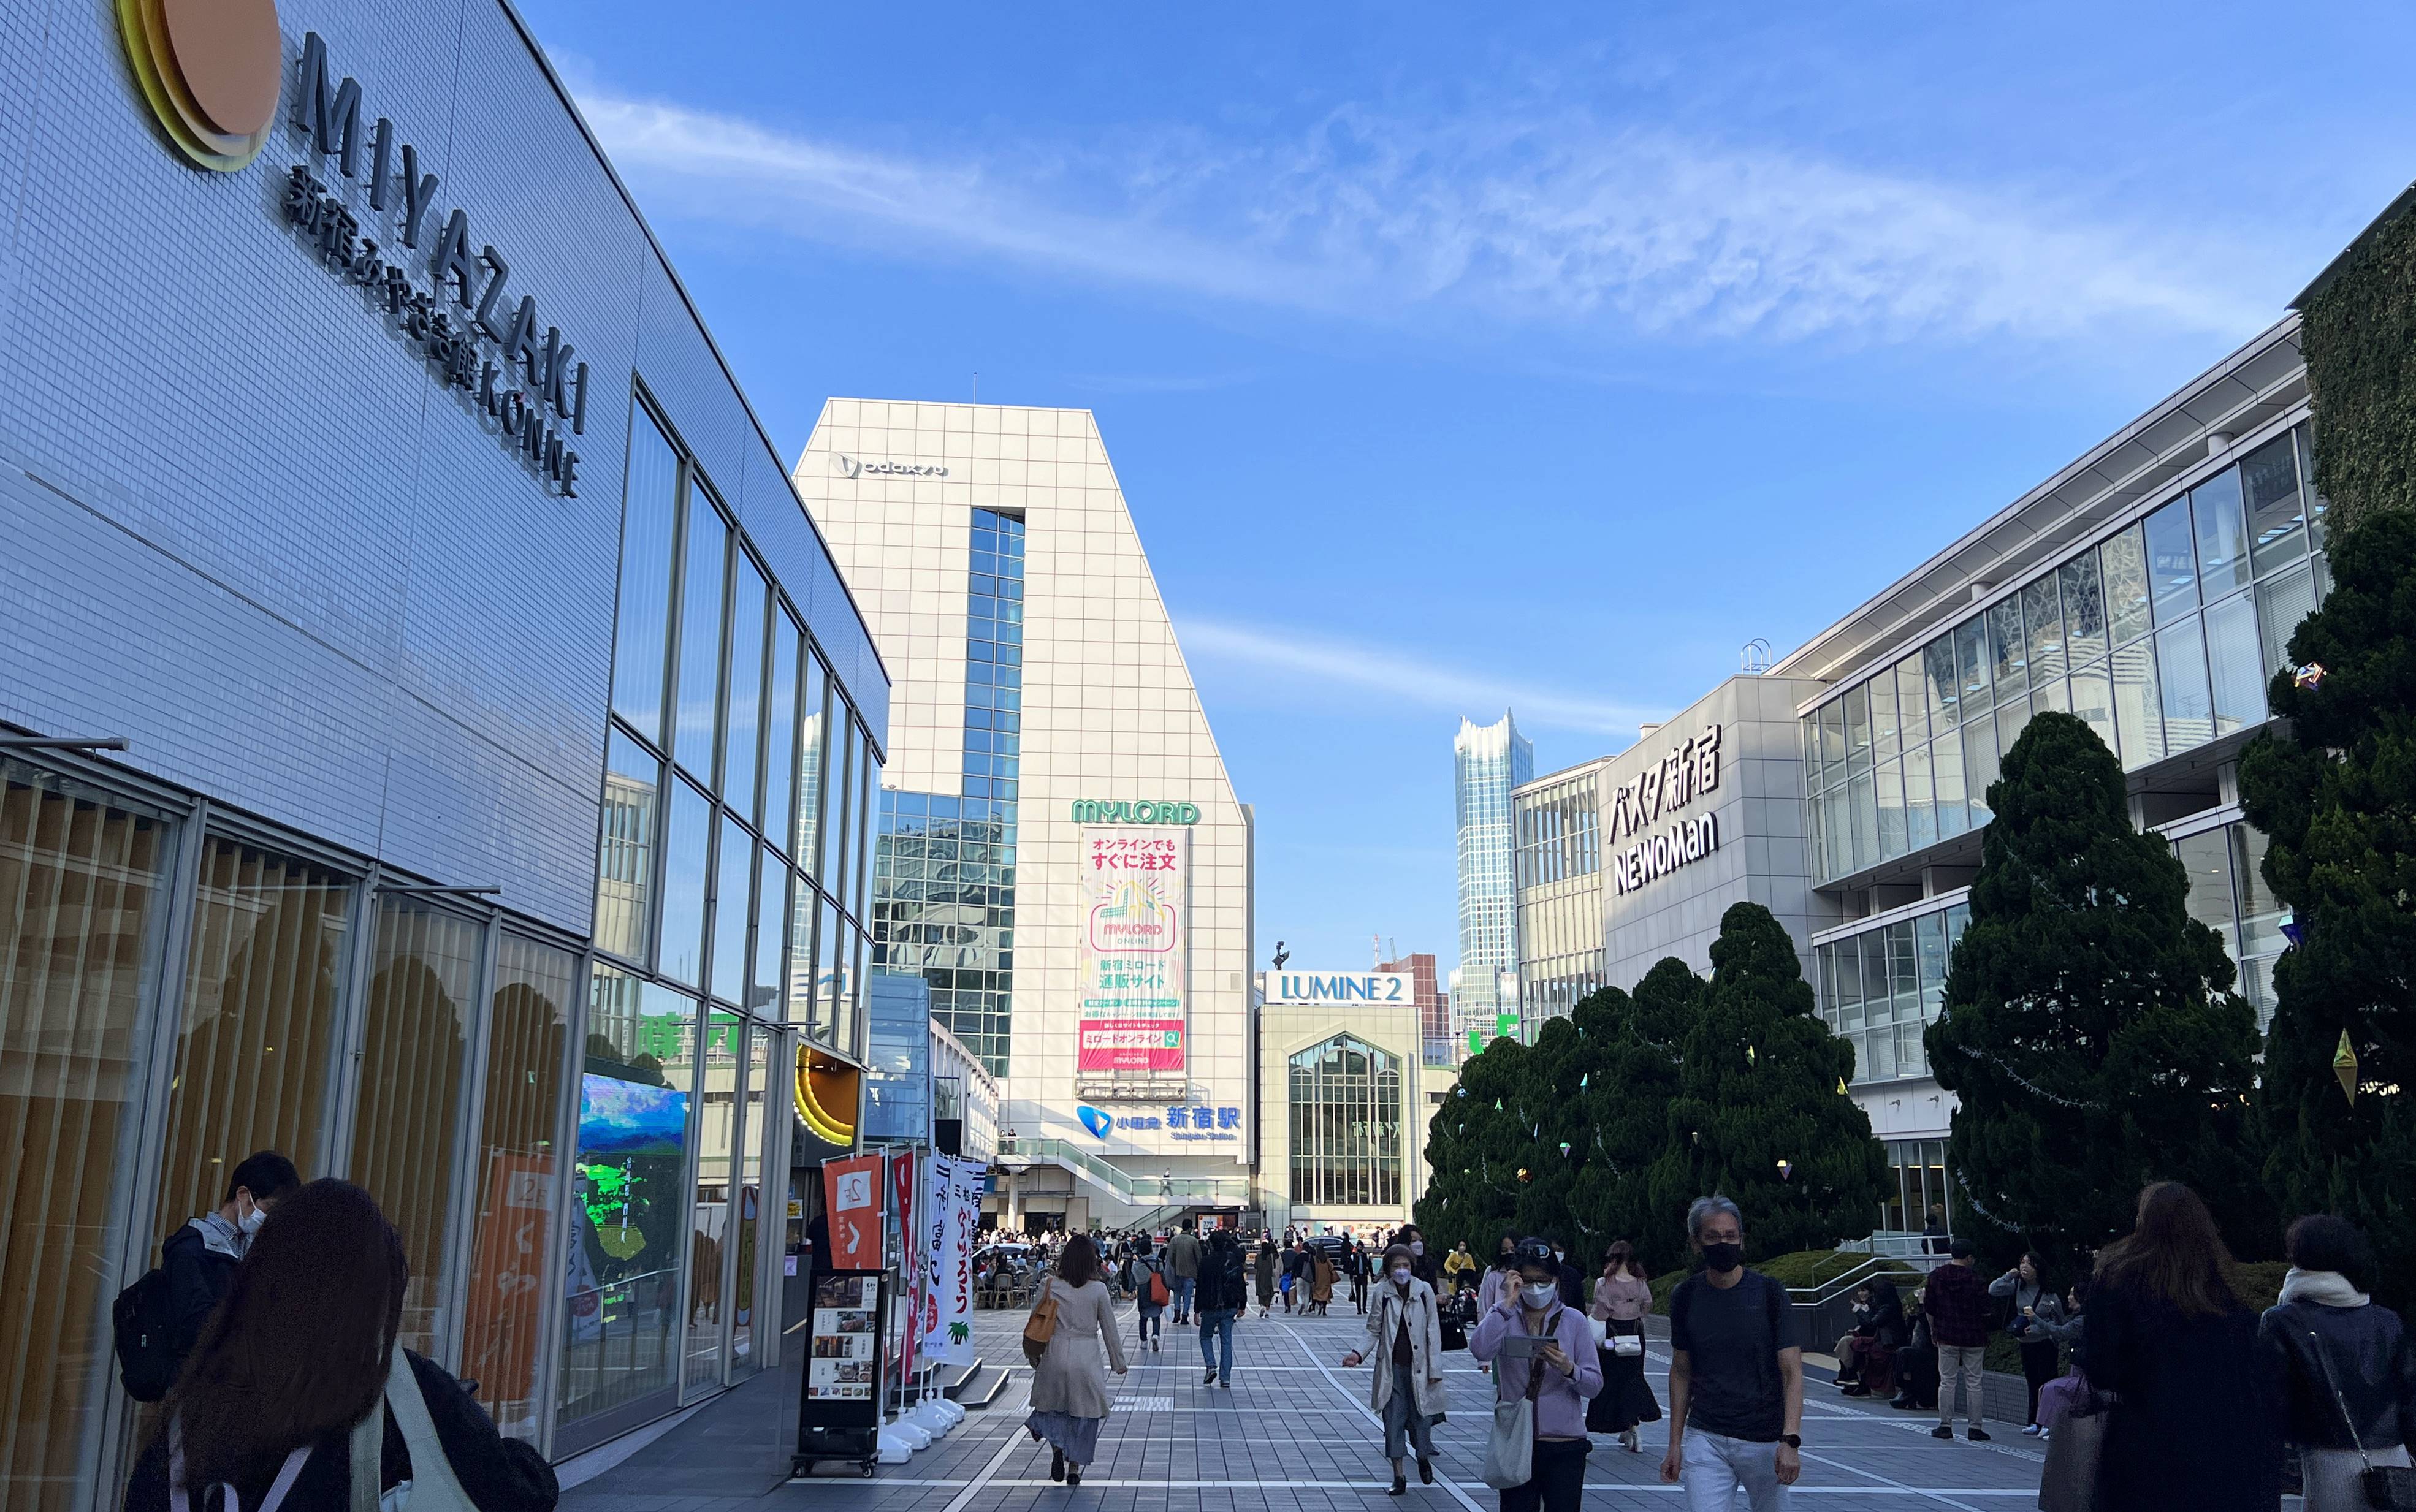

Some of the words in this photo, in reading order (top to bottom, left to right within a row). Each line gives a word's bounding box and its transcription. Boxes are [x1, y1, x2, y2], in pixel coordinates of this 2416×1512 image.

[295, 31, 589, 435] MIYAZAKI
[1607, 723, 1722, 845] バスタ新宿
[1071, 799, 1202, 824] MYLORD
[1092, 838, 1175, 851] オンラインでも
[1091, 853, 1176, 871] すぐに注文
[1103, 924, 1163, 935] MYLORD
[1100, 959, 1165, 971] 新宿ミロード
[1099, 974, 1165, 989] 通販サイト
[1281, 975, 1381, 1000] LUMINE
[1386, 976, 1403, 1001] 2
[1086, 1034, 1162, 1044] ミロードオンライン
[1115, 1116, 1162, 1130] 小田急
[1166, 1105, 1241, 1130] 新宿駅
